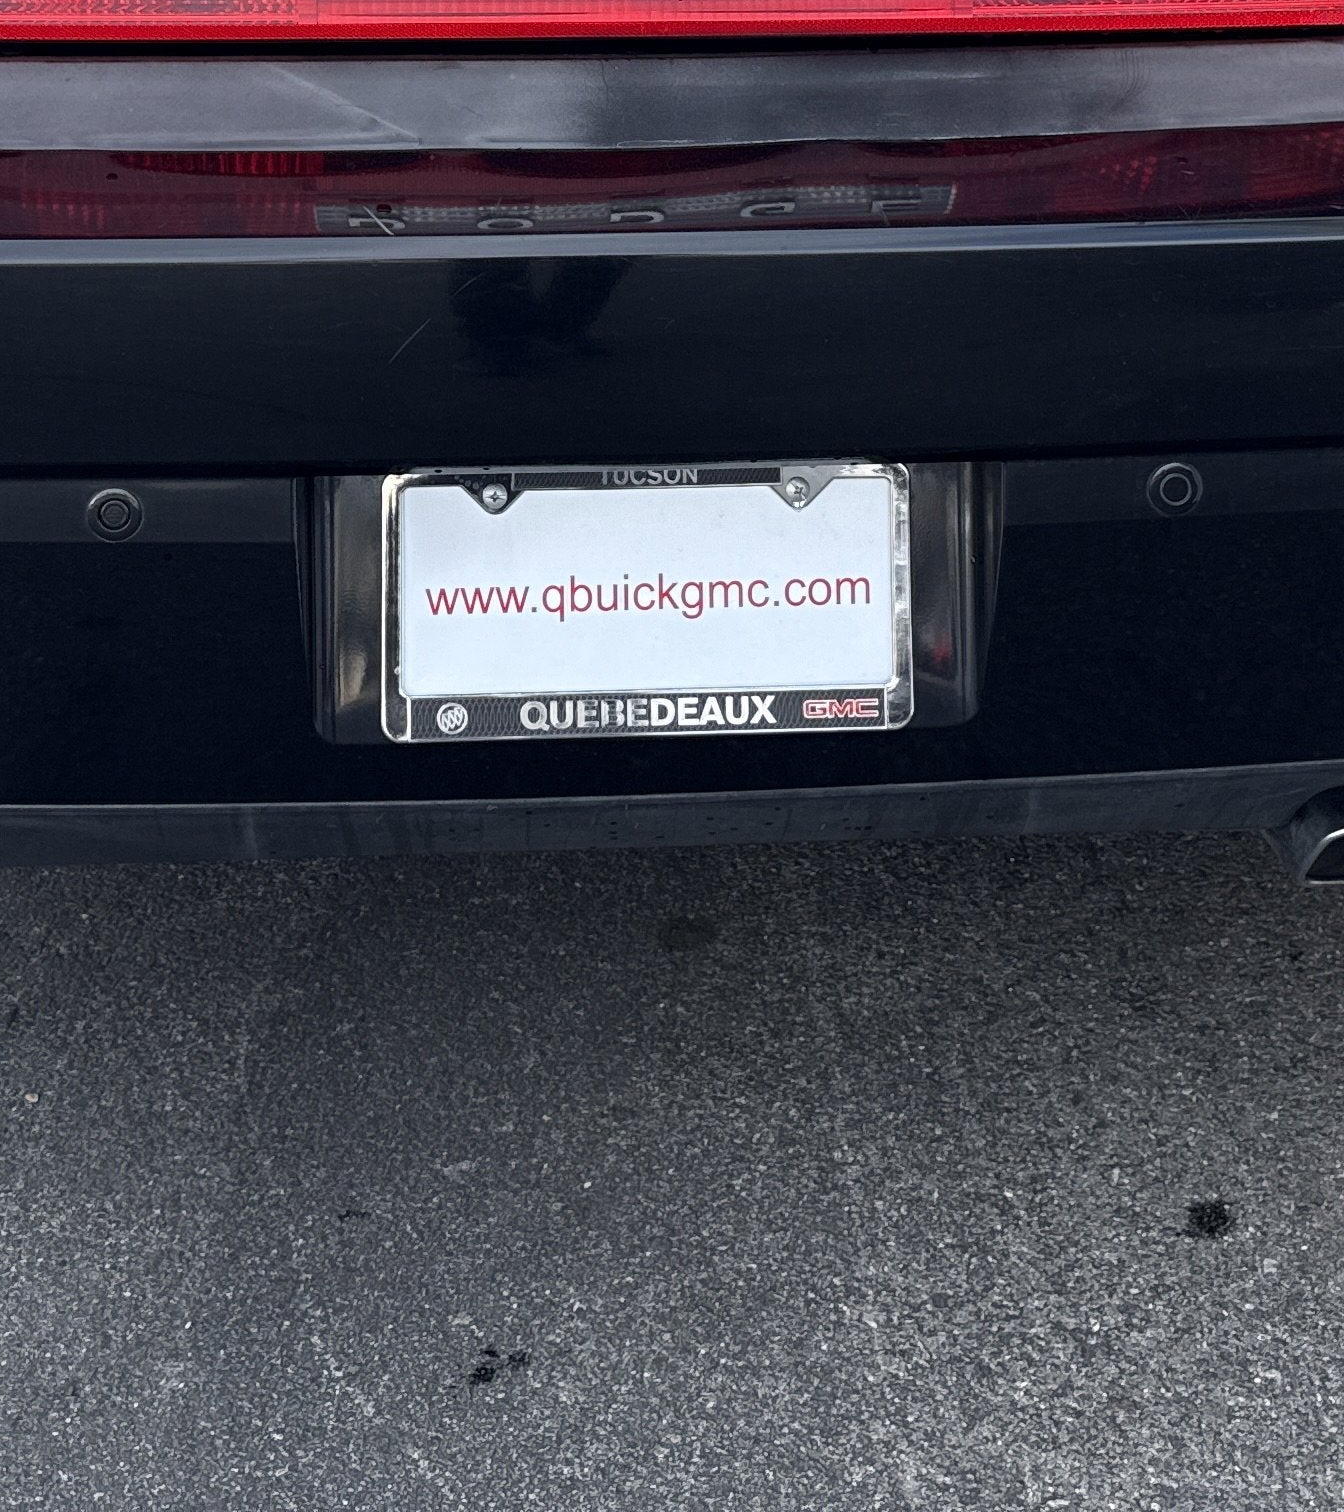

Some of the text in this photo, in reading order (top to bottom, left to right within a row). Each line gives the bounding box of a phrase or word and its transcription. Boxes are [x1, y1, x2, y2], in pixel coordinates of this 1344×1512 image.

[600, 467, 698, 486] TUCSON
[425, 573, 872, 622] www.qbuickgmc.com
[519, 694, 881, 732] QUEBEDEAUX GMC
